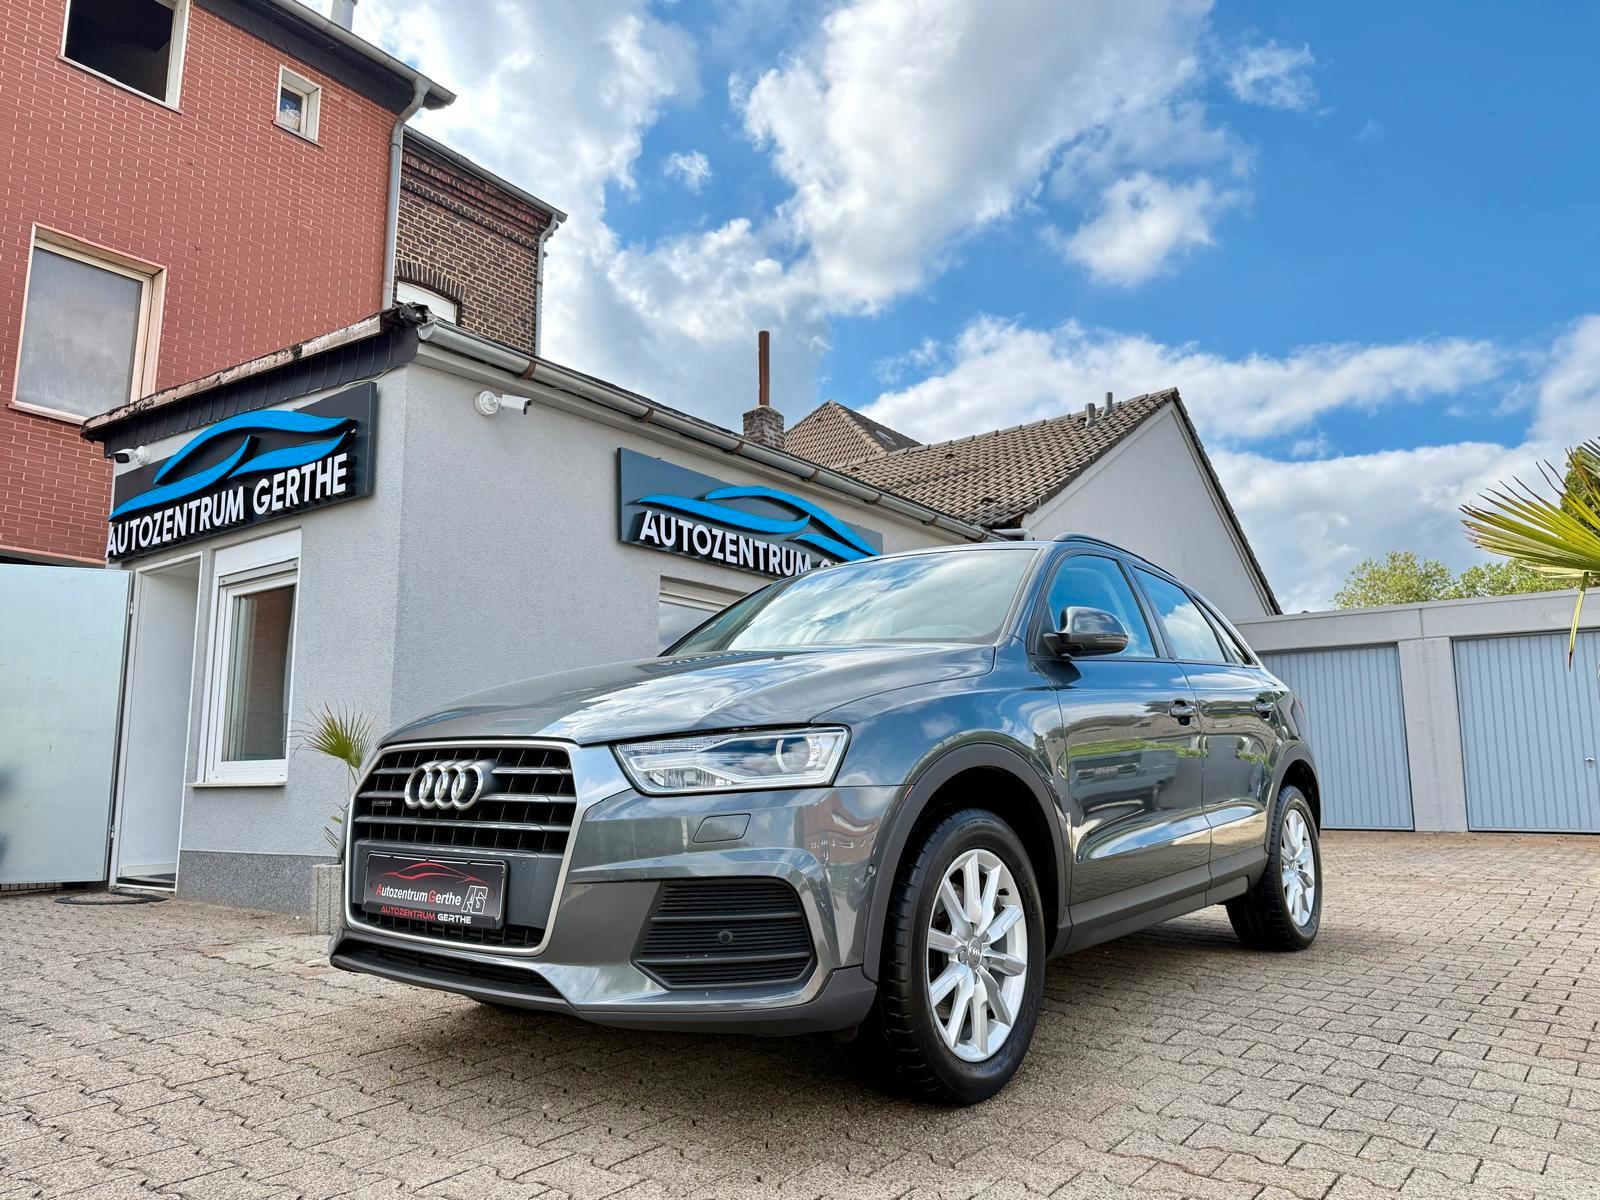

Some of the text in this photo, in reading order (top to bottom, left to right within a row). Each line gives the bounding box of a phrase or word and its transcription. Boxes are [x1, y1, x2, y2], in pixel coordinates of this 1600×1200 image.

[105, 452, 348, 558] AUTOZENTRUM GERTHE
[639, 510, 812, 577] AUTOZENTRUM
[376, 884, 462, 906] Autozentrum Gerthe
[380, 905, 472, 925] AUTOZENTRUM GERTHE
